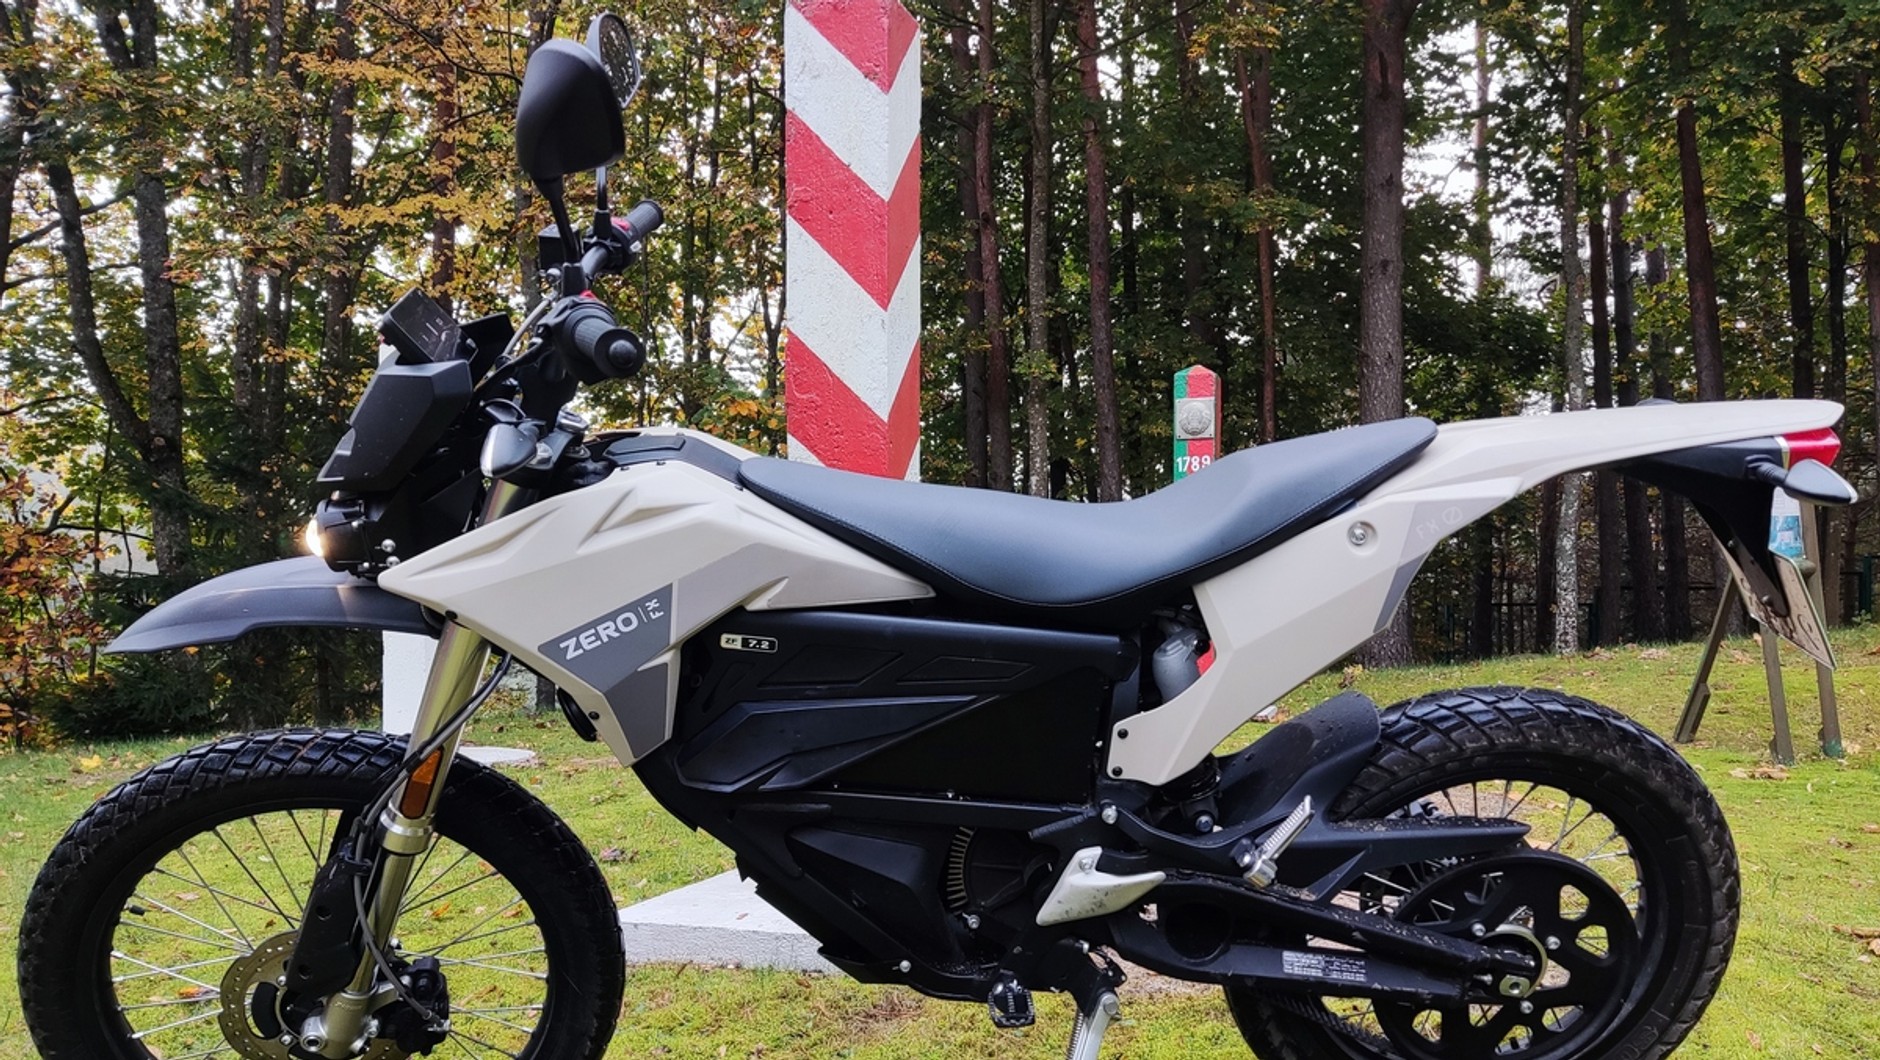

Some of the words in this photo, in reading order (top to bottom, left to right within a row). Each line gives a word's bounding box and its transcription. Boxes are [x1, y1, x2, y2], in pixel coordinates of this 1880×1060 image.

[1176, 455, 1211, 473] 1789
[559, 611, 639, 660] ZERO
[645, 598, 664, 620] FX
[748, 639, 770, 650] 7.2
